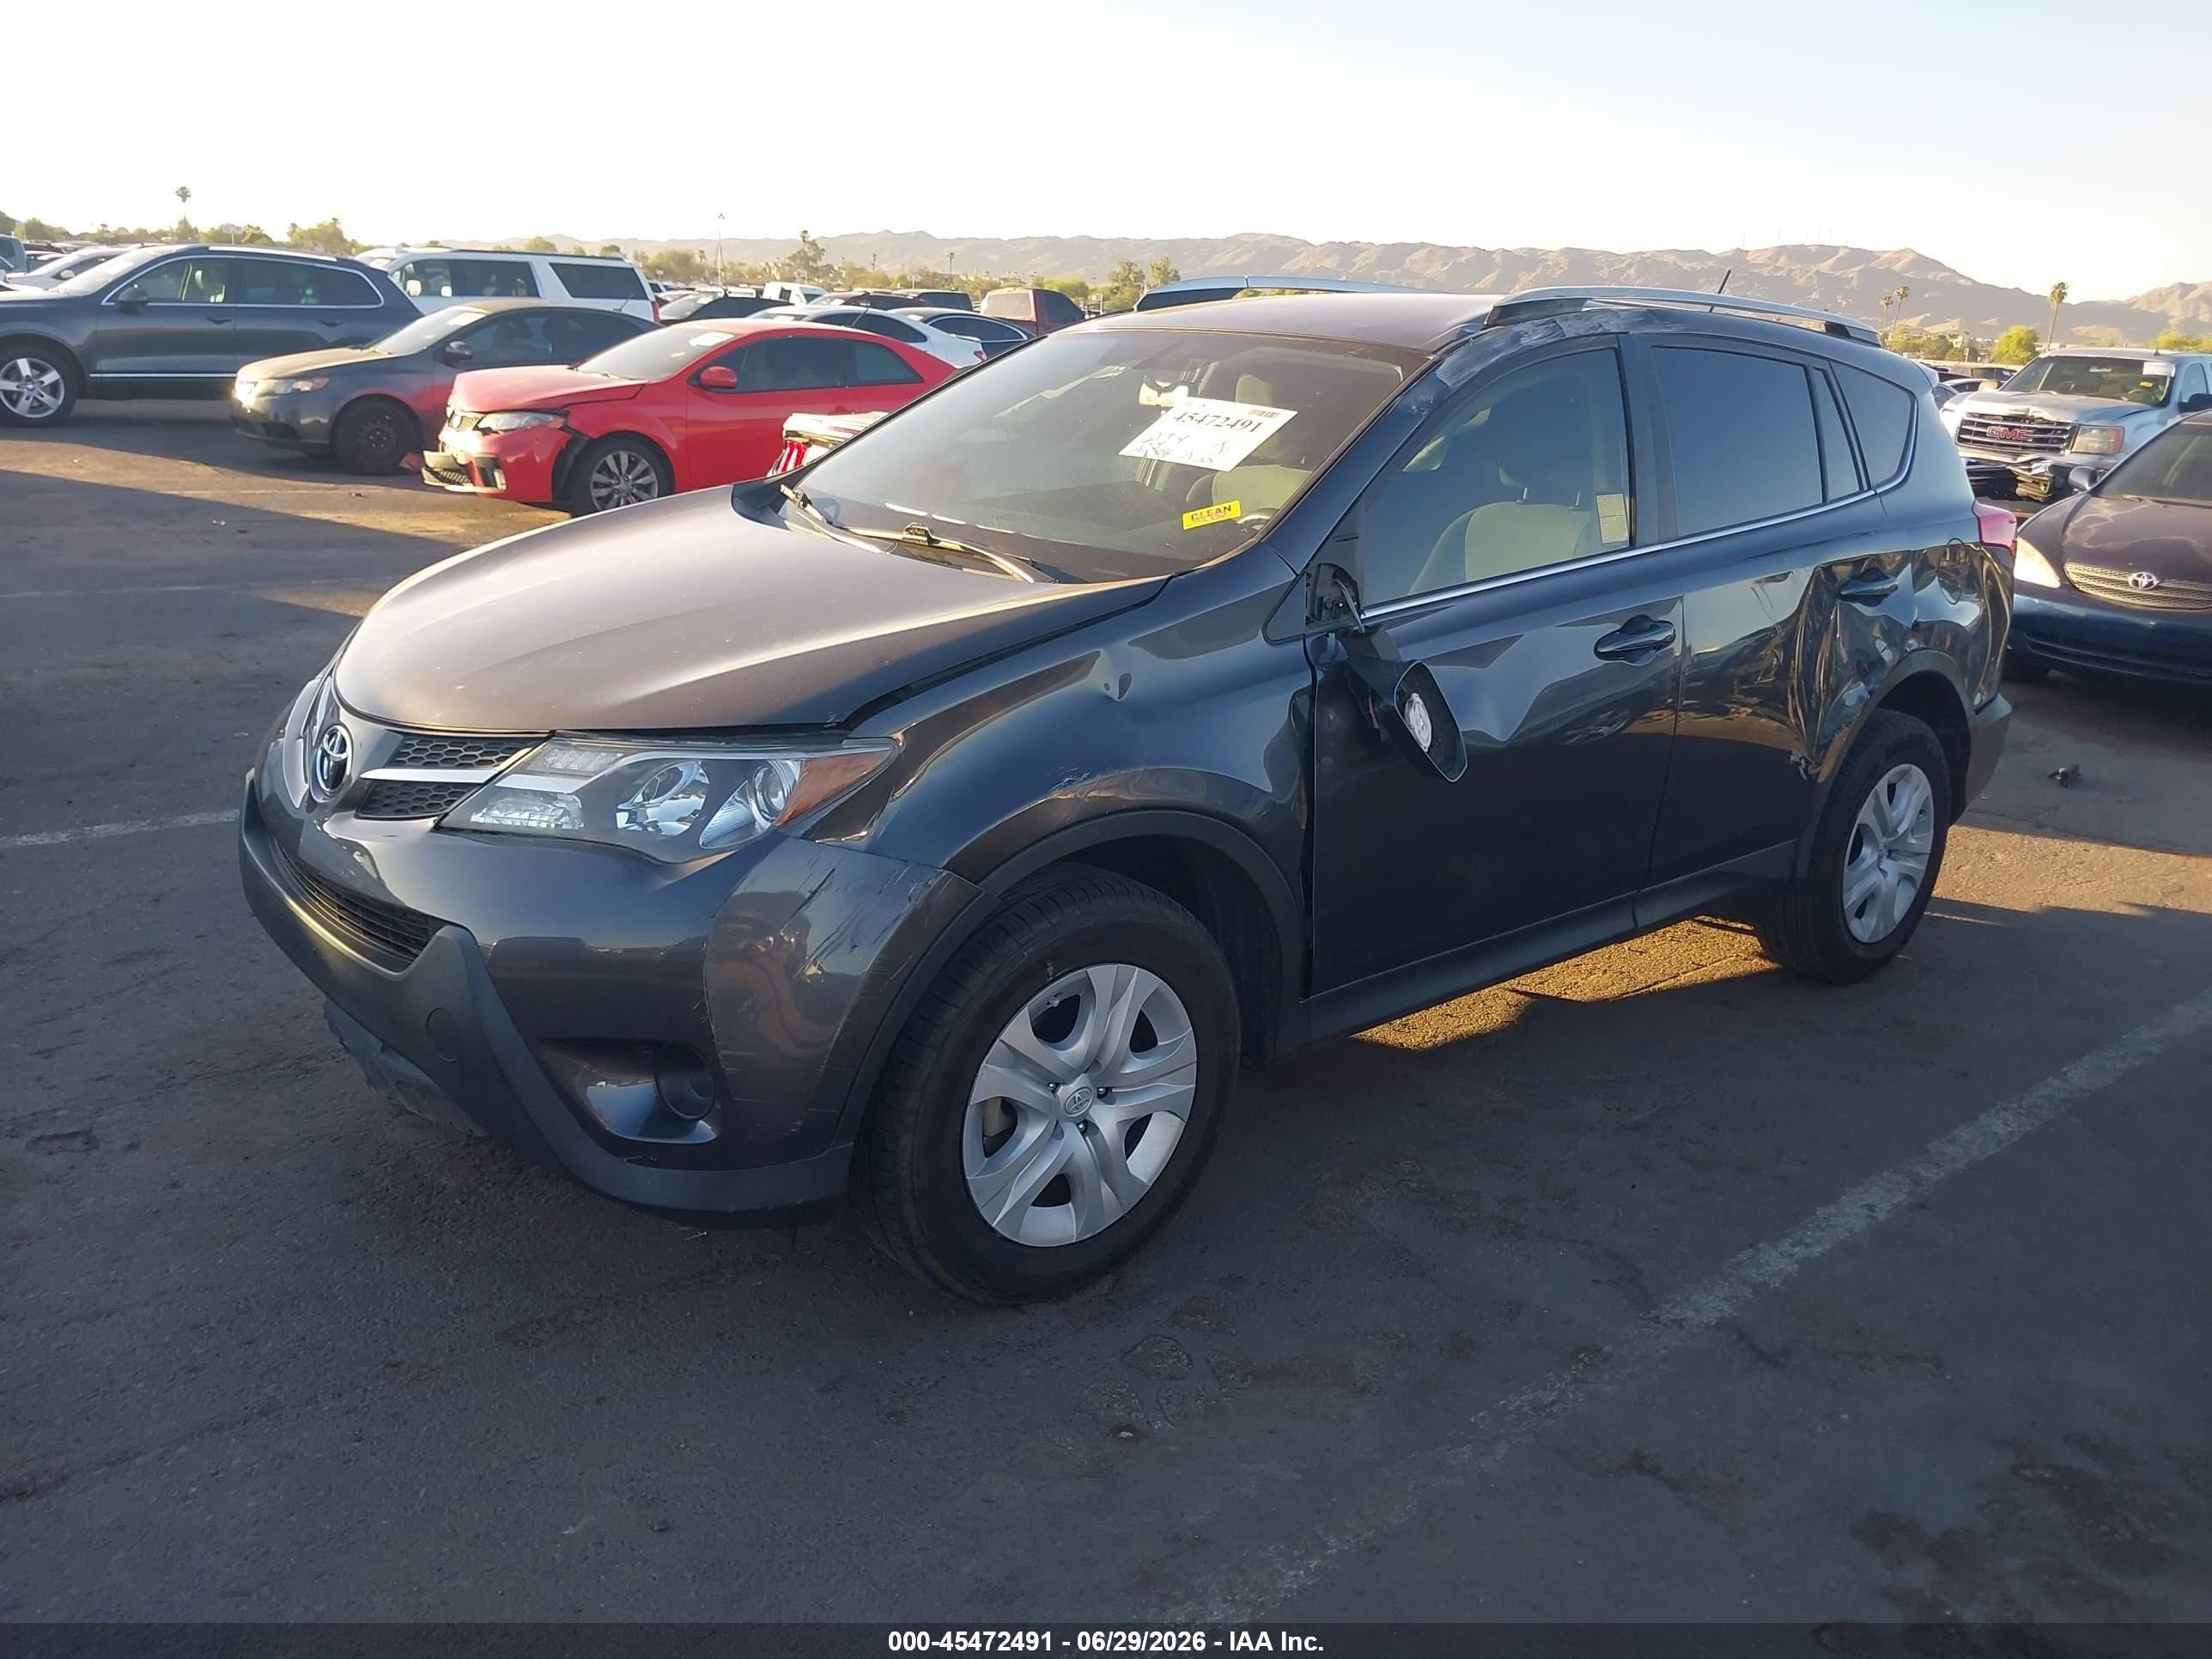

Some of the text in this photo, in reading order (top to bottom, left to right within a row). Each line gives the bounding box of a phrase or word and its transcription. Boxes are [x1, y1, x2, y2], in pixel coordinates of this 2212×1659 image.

[1173, 411, 1265, 433] 45472491
[1986, 425, 2033, 441] GMC
[1190, 505, 1232, 521] CLEAN
